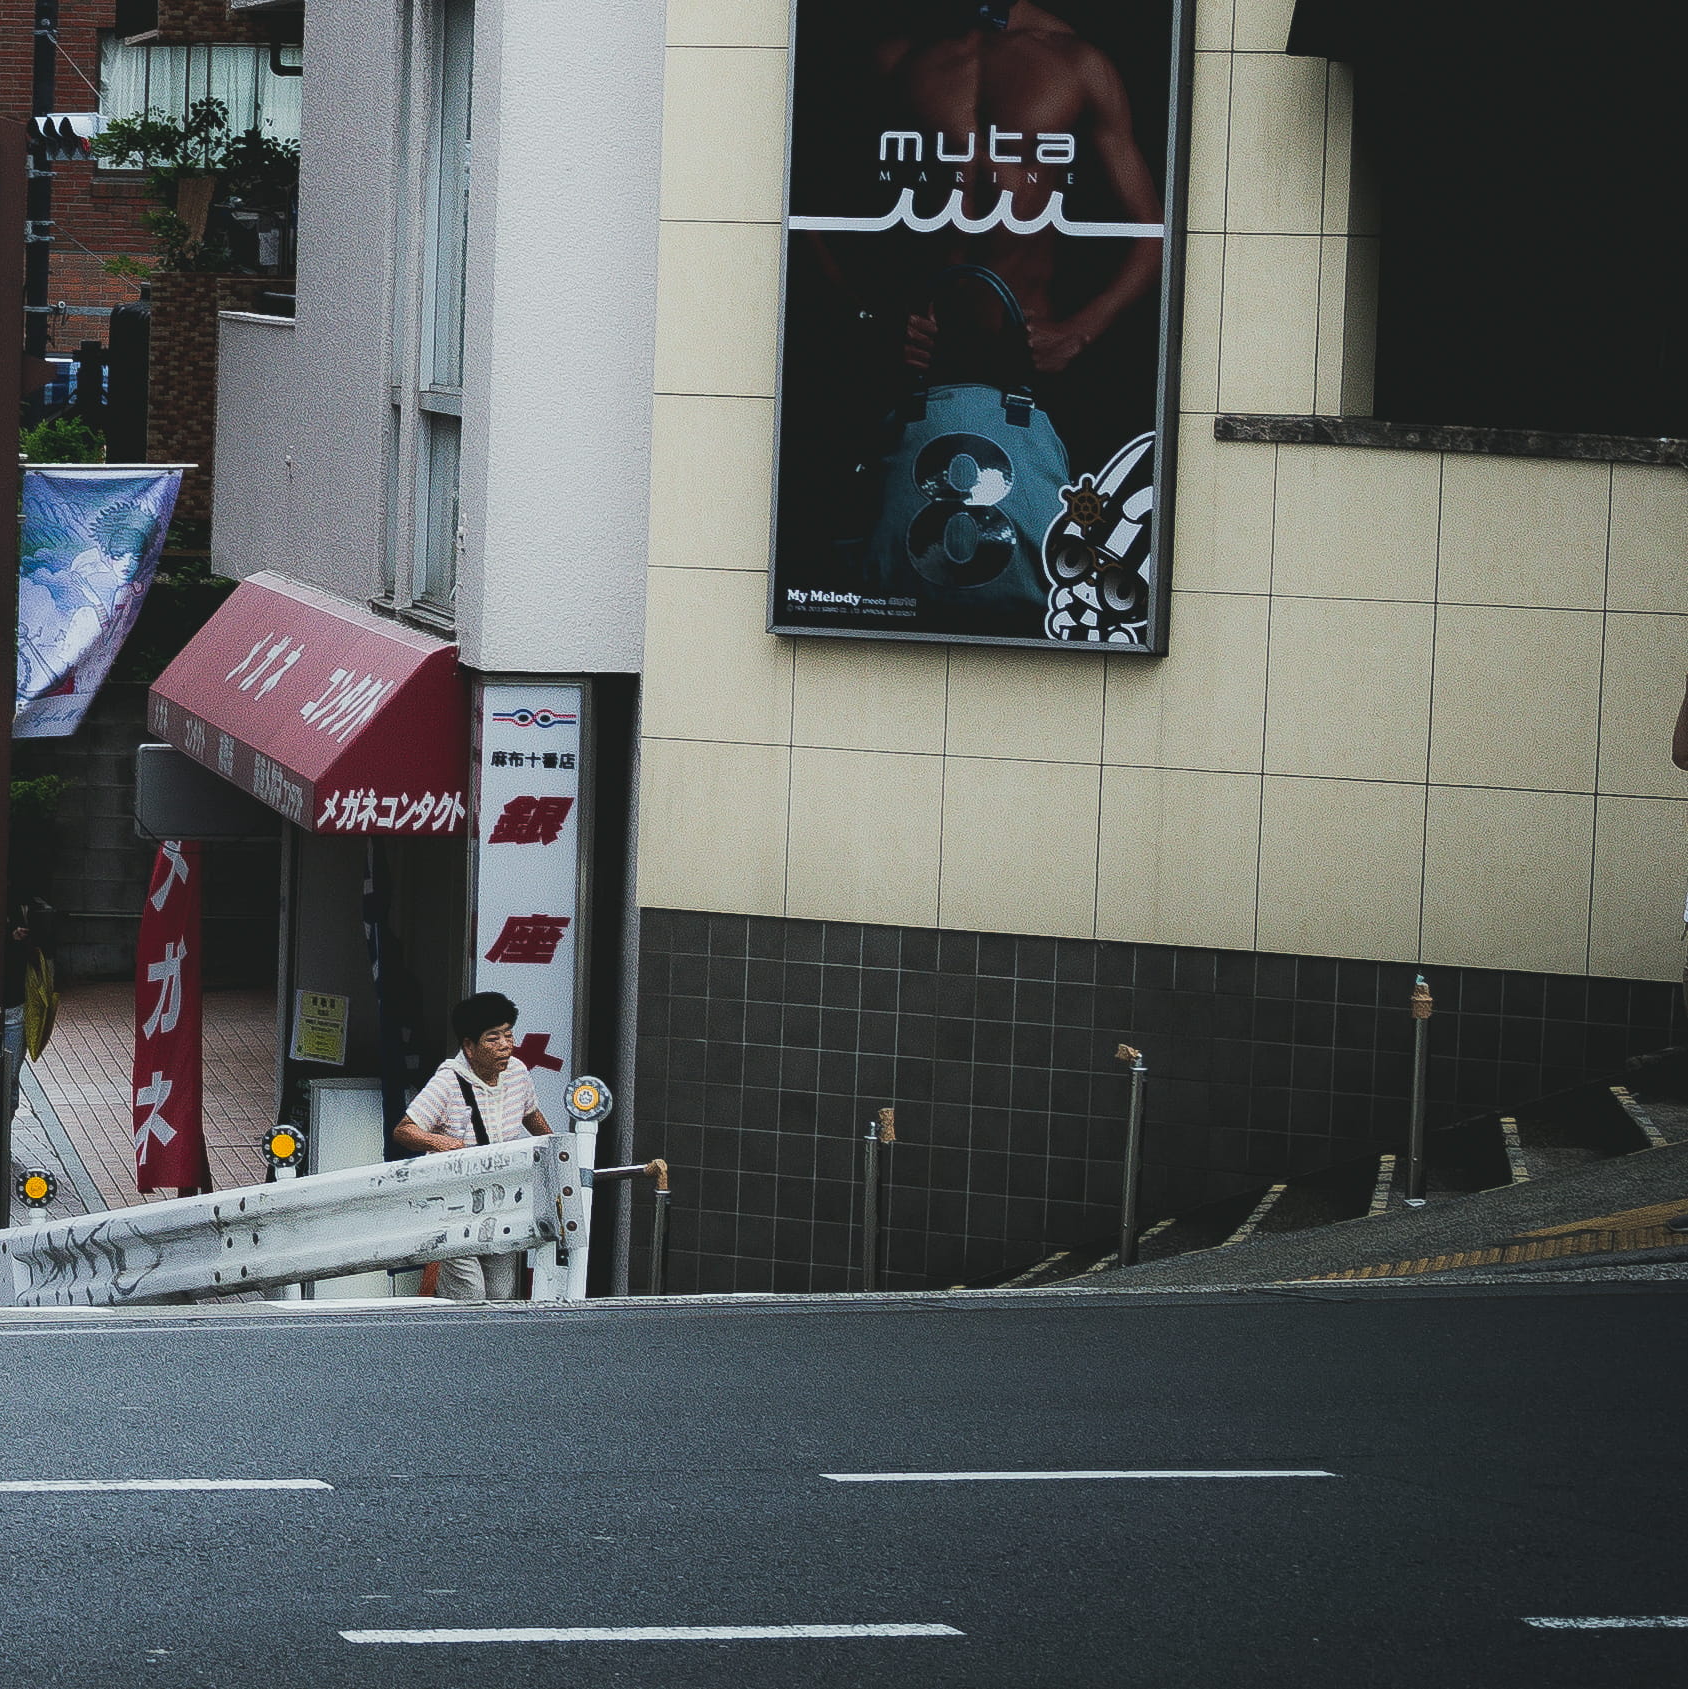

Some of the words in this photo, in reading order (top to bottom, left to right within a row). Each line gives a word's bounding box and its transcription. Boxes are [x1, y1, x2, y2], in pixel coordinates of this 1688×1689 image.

[879, 124, 1075, 164] muta
[879, 170, 1074, 185] MARINE
[786, 588, 807, 604] My
[810, 589, 862, 606] Melody
[490, 750, 577, 771] 麻布十番店
[317, 787, 466, 831] メガネコンタクト
[134, 840, 190, 1169] メガネ
